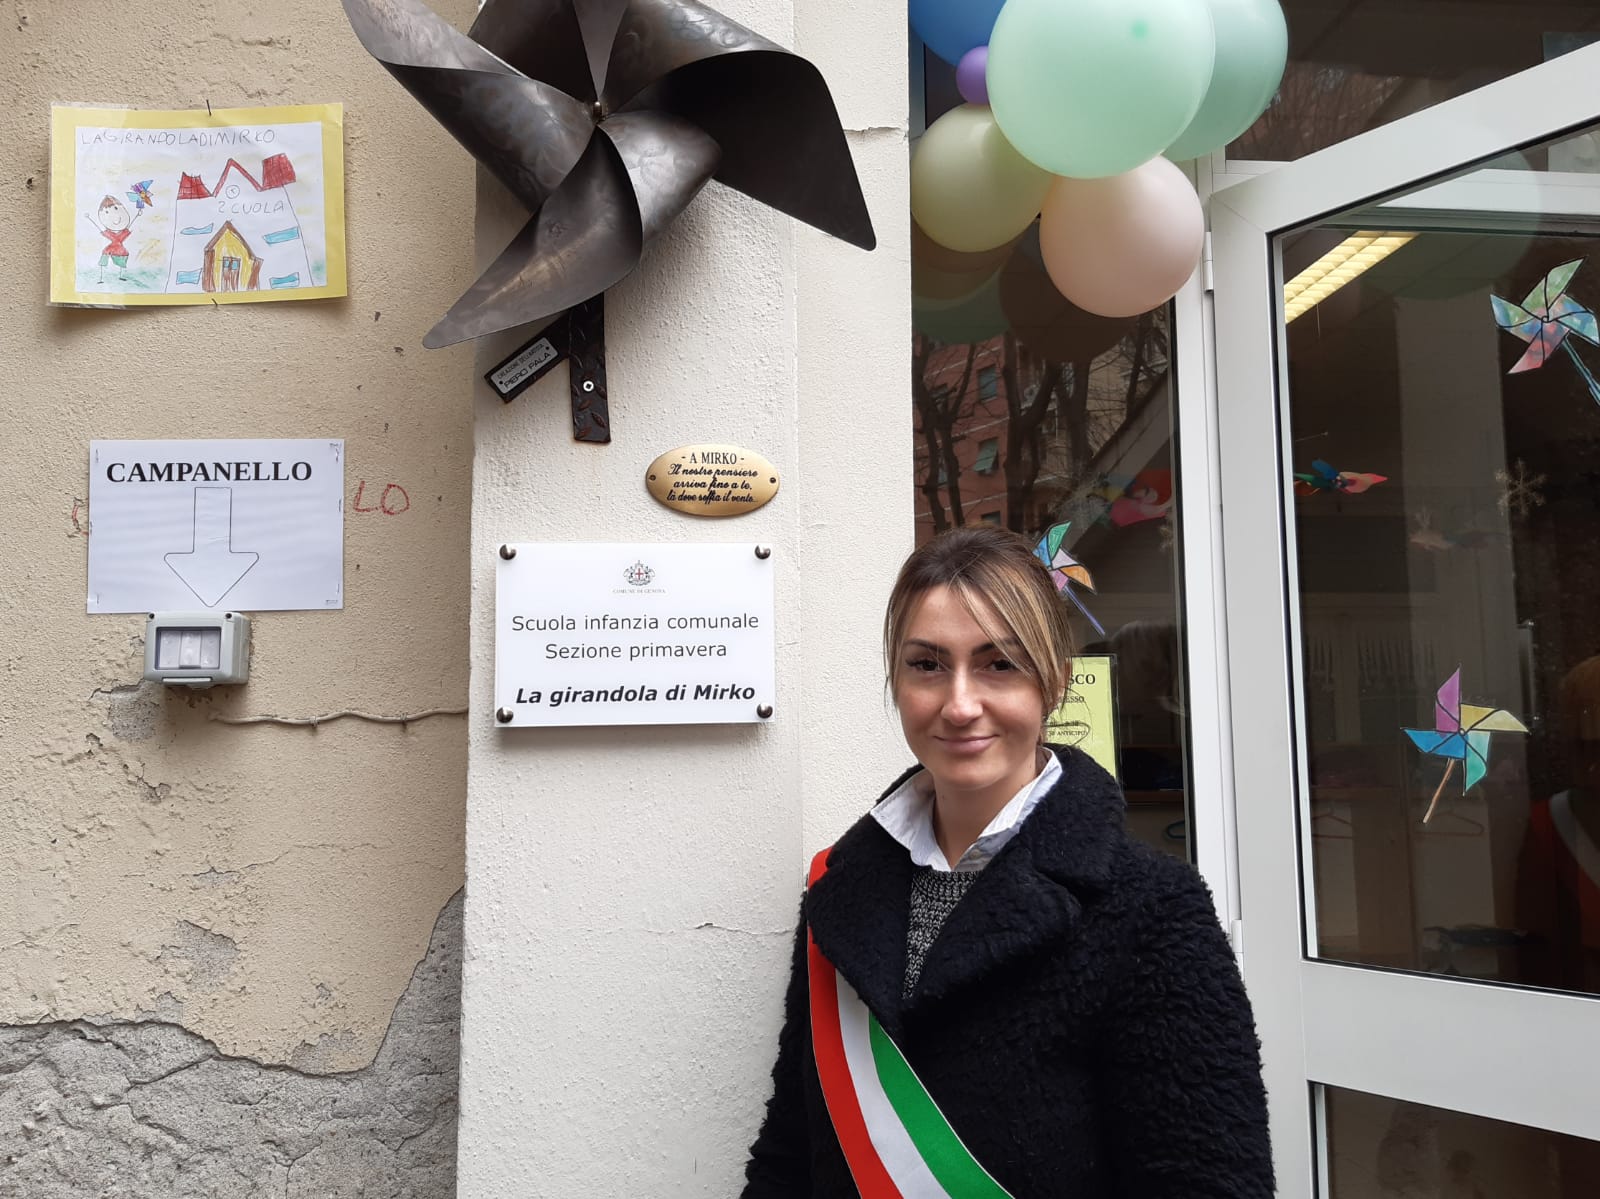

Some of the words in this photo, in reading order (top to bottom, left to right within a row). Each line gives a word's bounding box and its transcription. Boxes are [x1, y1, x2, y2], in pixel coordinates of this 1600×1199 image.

[504, 368, 528, 388] PIERO
[528, 352, 551, 370] PALA
[689, 453, 697, 464] A
[701, 452, 738, 465] MIRKO
[106, 460, 313, 483] CAMPANELLO
[668, 463, 682, 475] Il
[683, 467, 714, 476] nostro
[713, 468, 758, 480] pensiero
[673, 479, 708, 489] arriva
[708, 477, 730, 491] fino
[677, 490, 698, 502] dove
[698, 490, 722, 505] soffia
[722, 490, 732, 502] il
[512, 615, 577, 632] Scuola
[584, 614, 660, 631] infanzia
[666, 613, 760, 630] comunale
[545, 643, 622, 660] Sezione
[629, 642, 728, 662] primavera
[516, 687, 542, 704] La
[549, 685, 658, 707] girandola
[665, 684, 686, 701] di
[693, 683, 756, 701] Mirko
